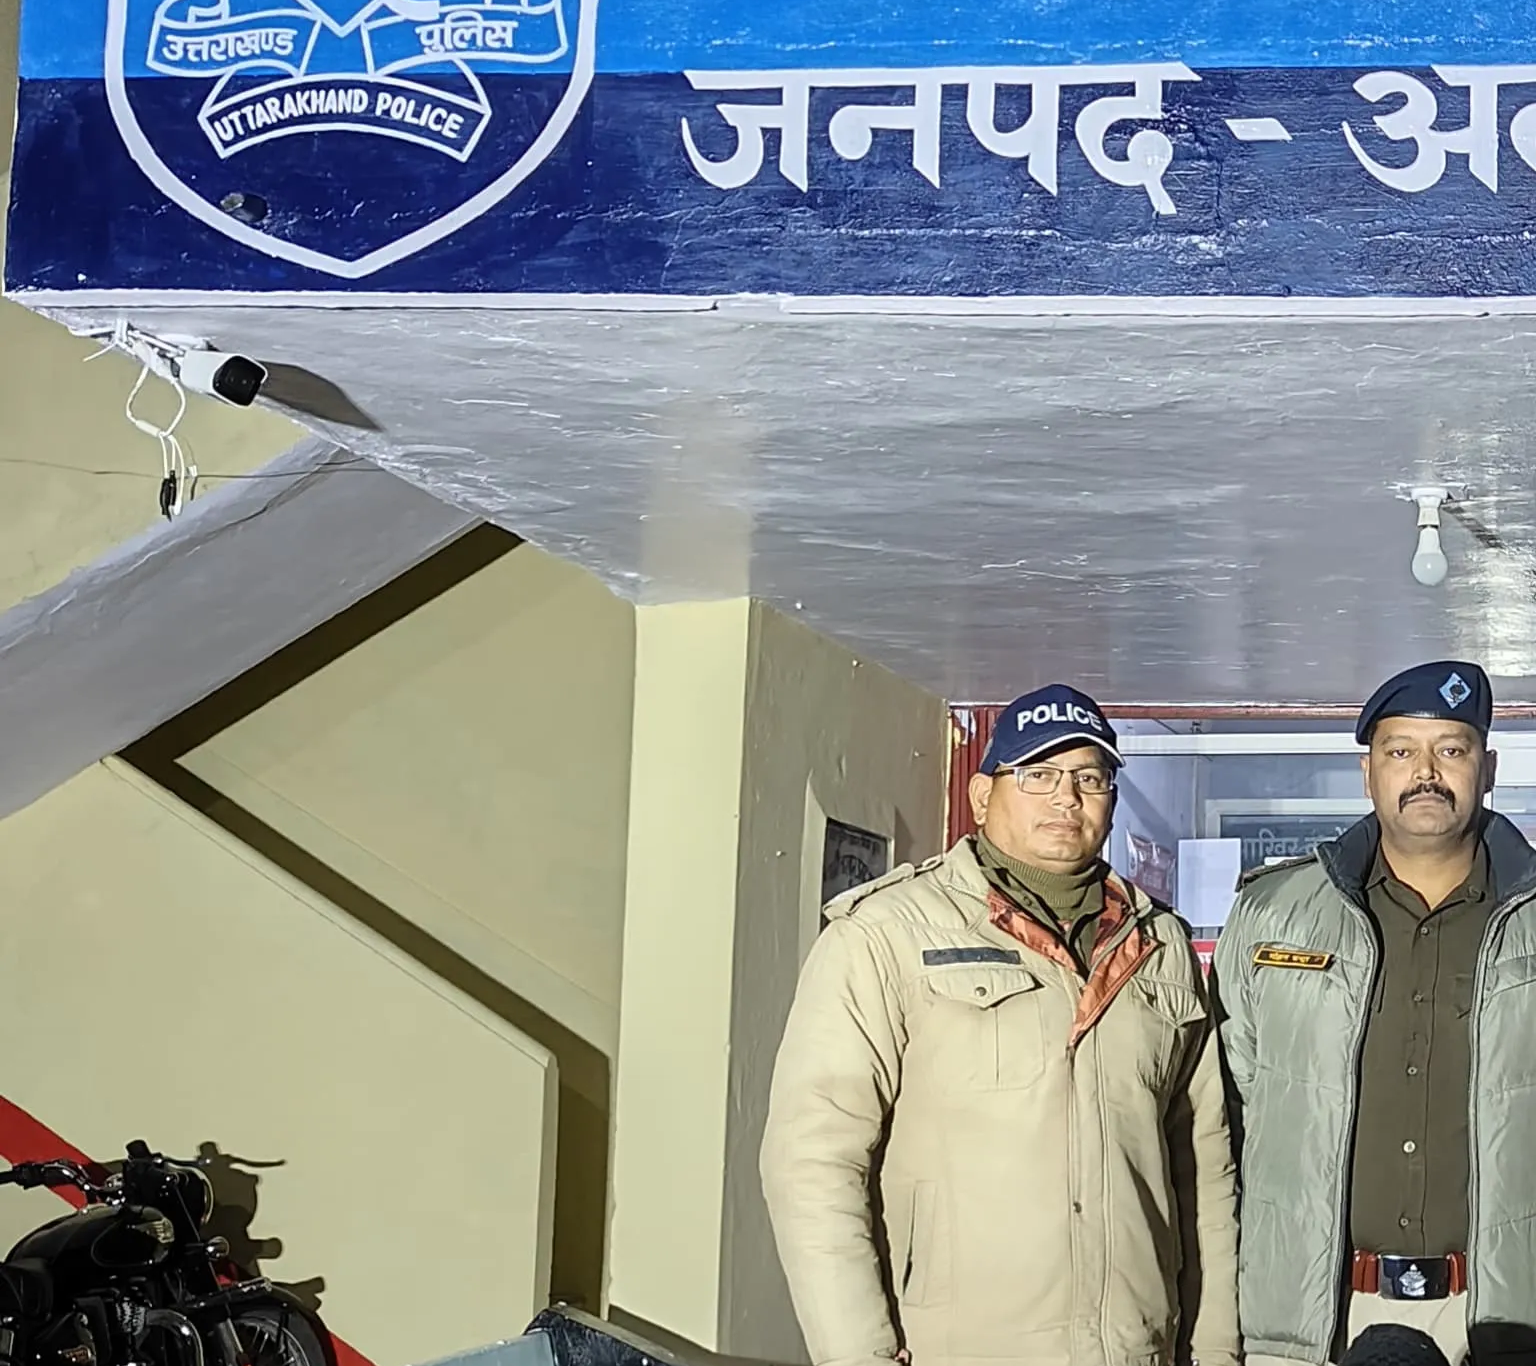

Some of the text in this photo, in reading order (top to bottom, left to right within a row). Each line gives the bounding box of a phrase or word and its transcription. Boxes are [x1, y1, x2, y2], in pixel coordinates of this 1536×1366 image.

[162, 26, 299, 64] उत्तराखण्ड
[415, 12, 518, 54] पुलिस
[213, 87, 465, 142] UTTARAKHAND POLICE
[681, 62, 1202, 217] जनपद
[1016, 702, 1104, 732] POLICE
